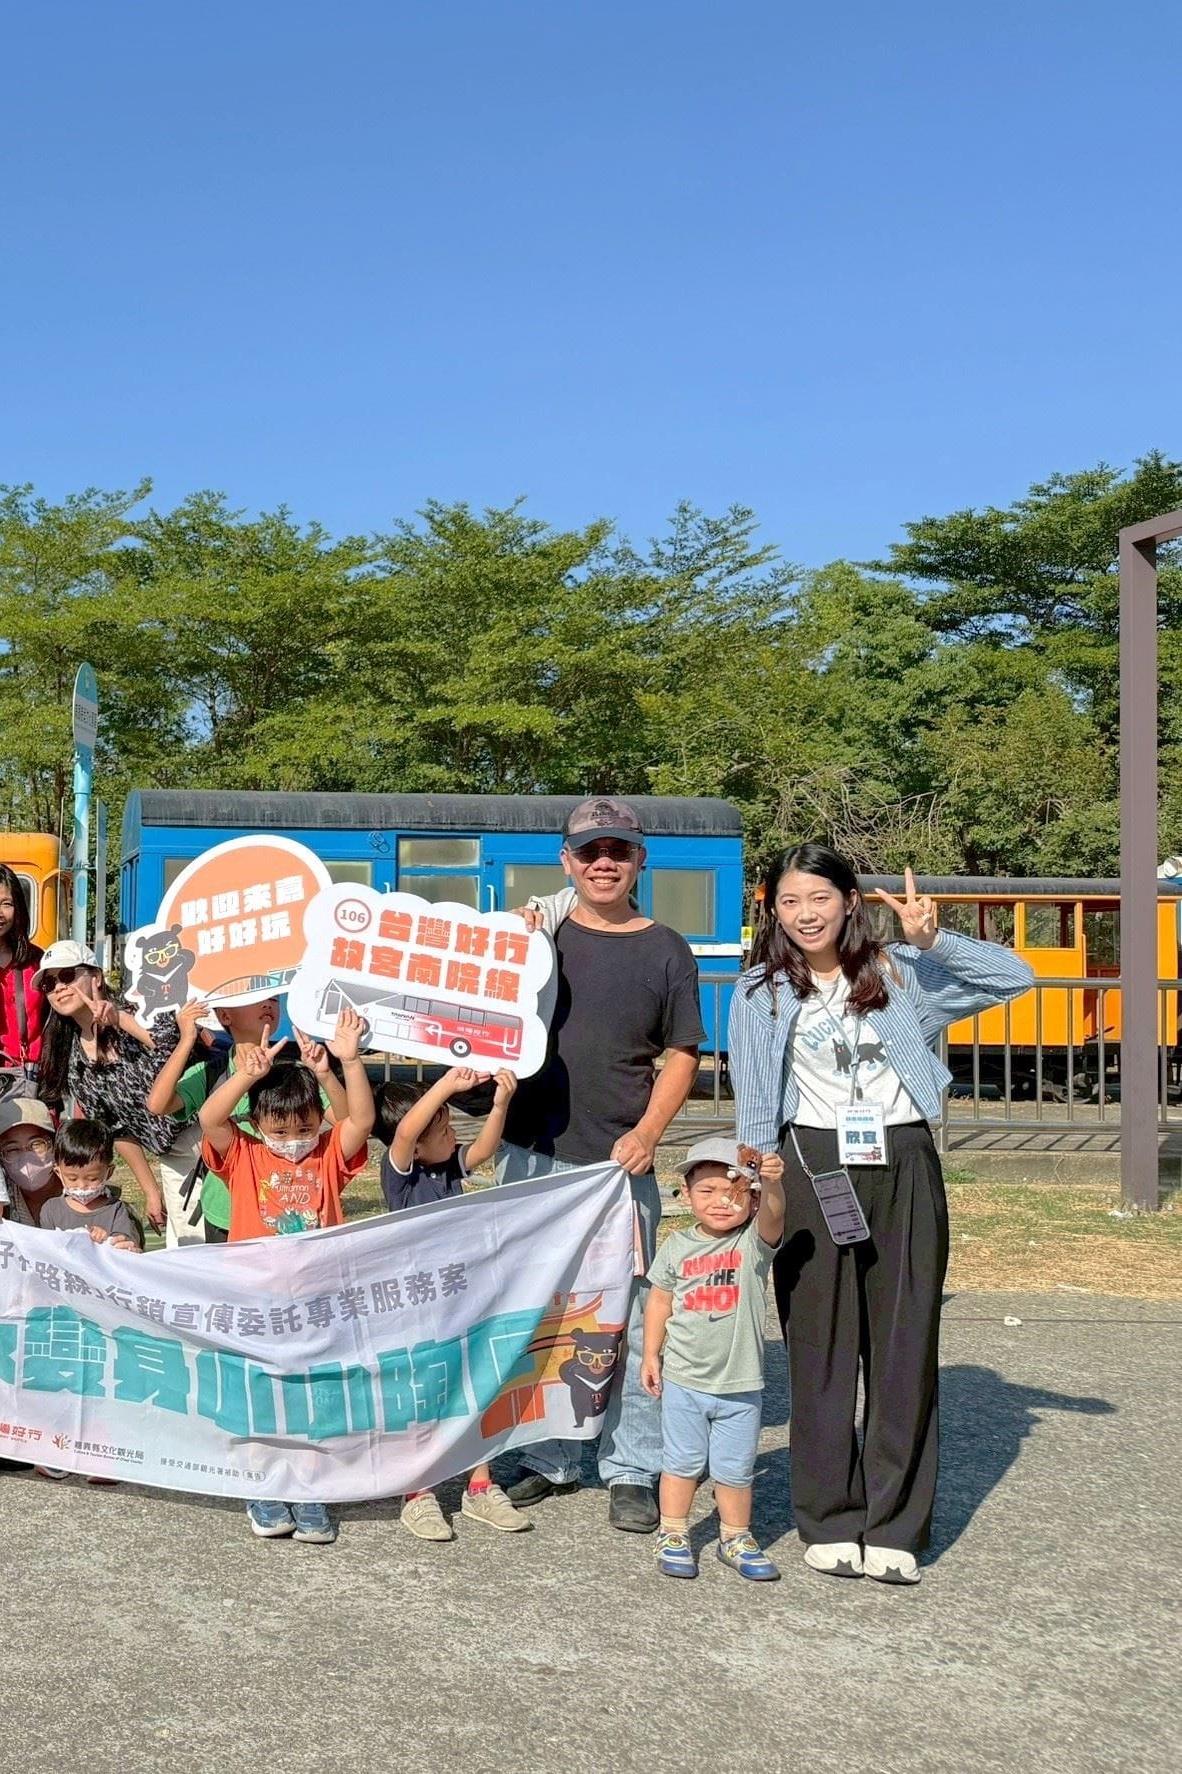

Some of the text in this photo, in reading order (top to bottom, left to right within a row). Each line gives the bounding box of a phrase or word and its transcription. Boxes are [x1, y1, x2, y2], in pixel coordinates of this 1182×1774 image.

[180, 874, 305, 929] 歡迎來嘉
[197, 910, 291, 956] 好好玩
[340, 909, 530, 966] 106 台灣好行
[330, 936, 520, 1003] 故宮南院線
[280, 1192, 311, 1205] AND
[705, 1268, 736, 1287] THE
